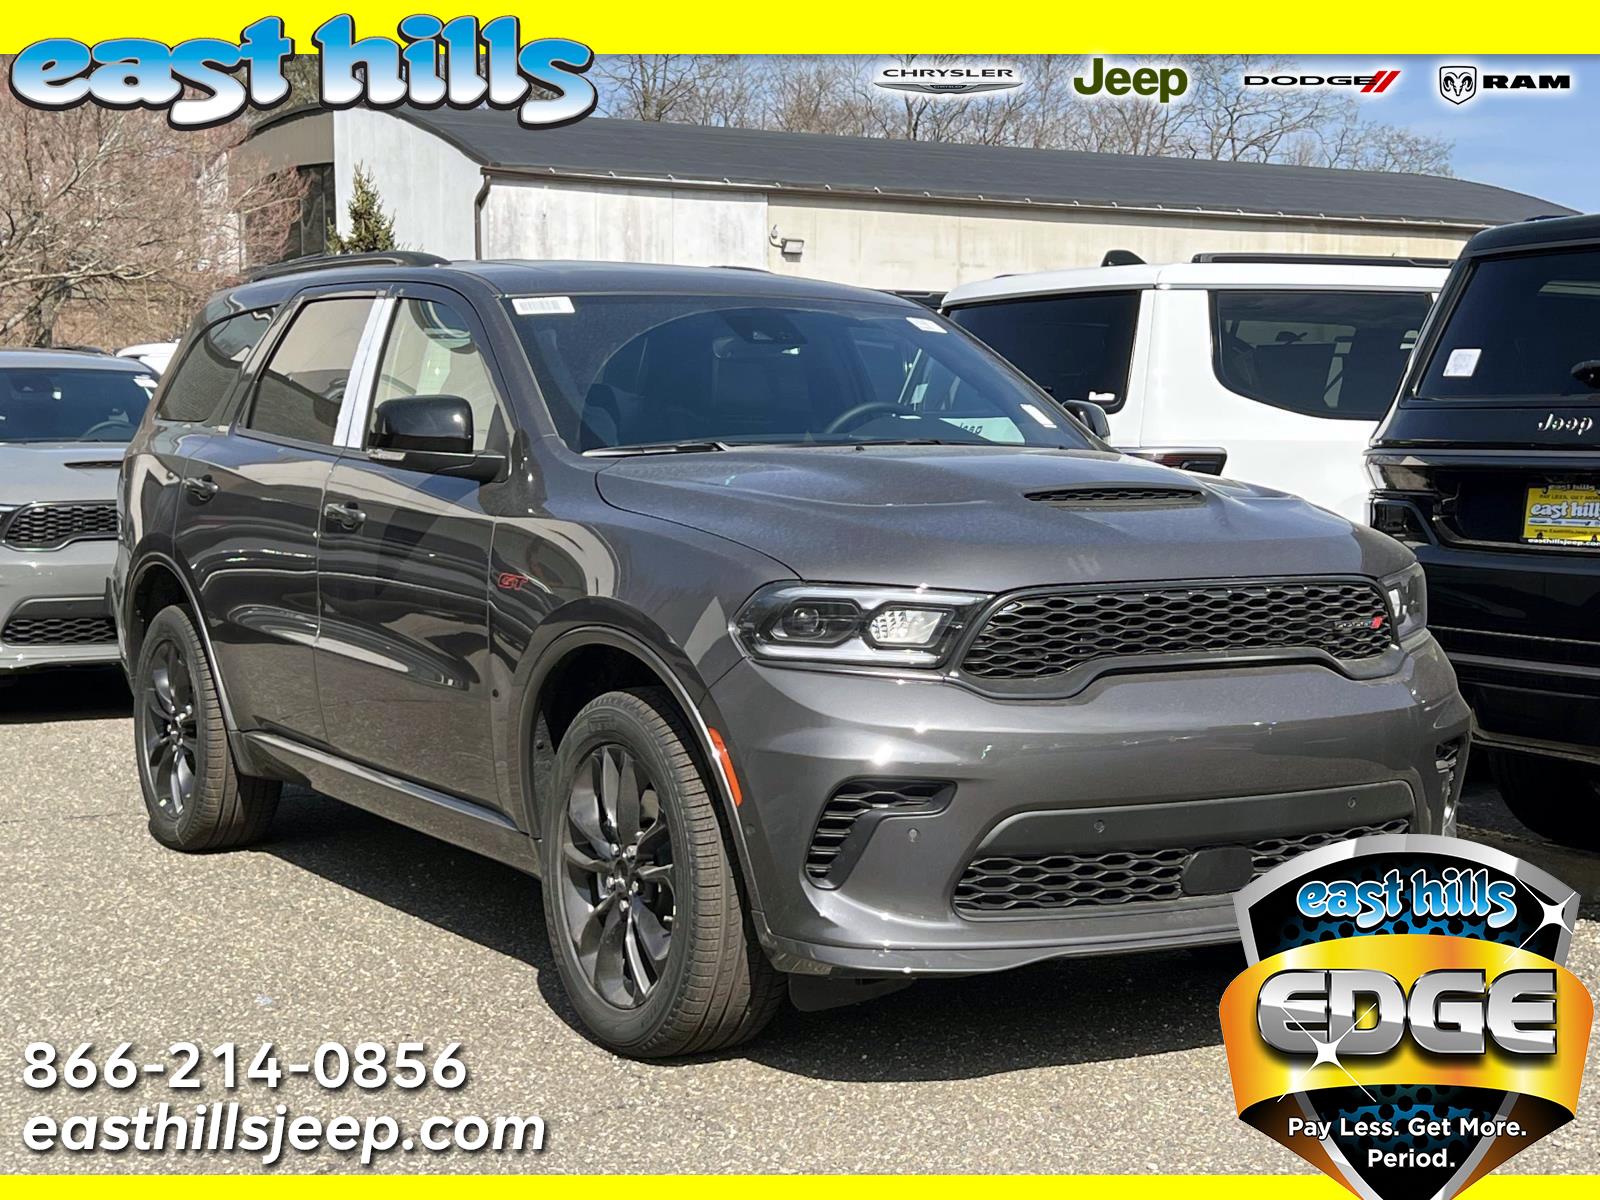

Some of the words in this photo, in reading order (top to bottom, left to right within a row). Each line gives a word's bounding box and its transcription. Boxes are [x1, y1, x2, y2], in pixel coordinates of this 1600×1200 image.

[1537, 413, 1593, 436] Jeep
[1530, 501, 1568, 519] east
[1571, 501, 1600, 518] hill
